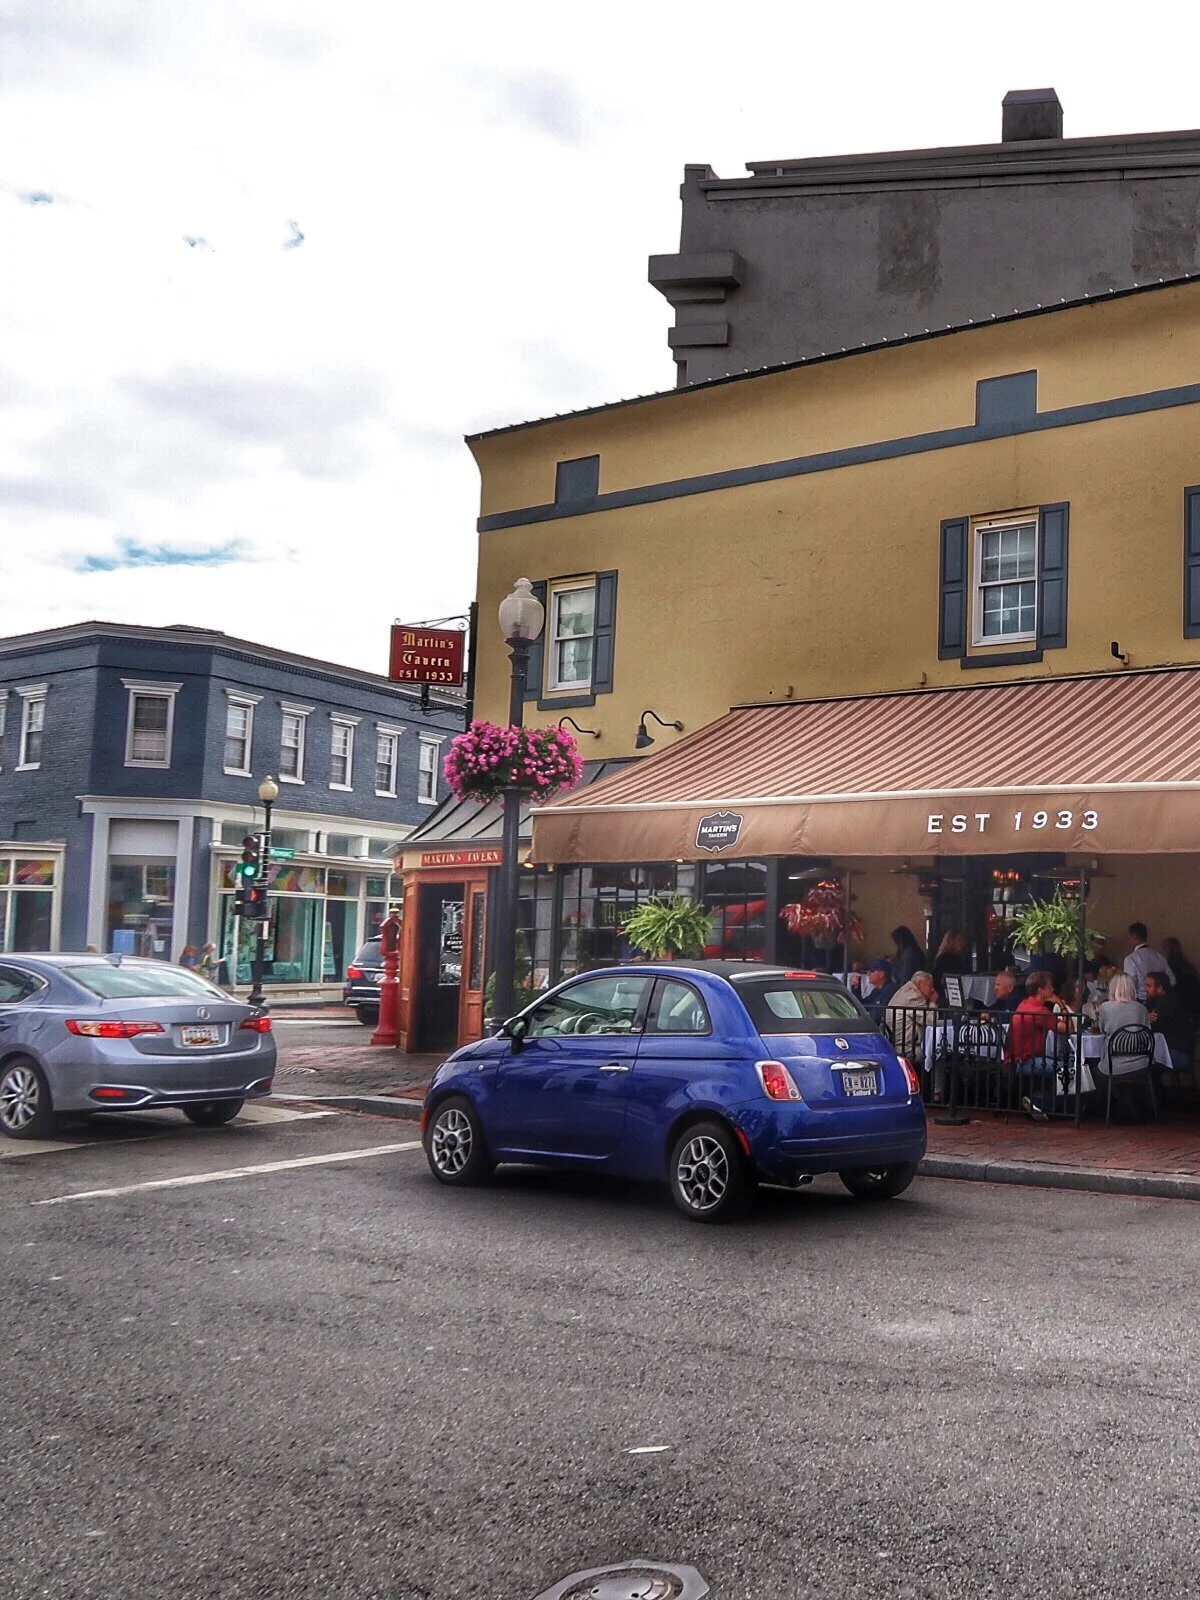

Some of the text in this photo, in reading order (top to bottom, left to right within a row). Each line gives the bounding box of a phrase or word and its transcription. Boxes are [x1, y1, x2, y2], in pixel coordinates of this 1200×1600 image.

[401, 631, 454, 649] Martin's
[402, 650, 450, 667] Tavern
[425, 671, 453, 681] 1933
[701, 824, 737, 833] MARTIN'S
[927, 810, 1098, 833] EST 1933
[467, 851, 499, 862] TAVERN
